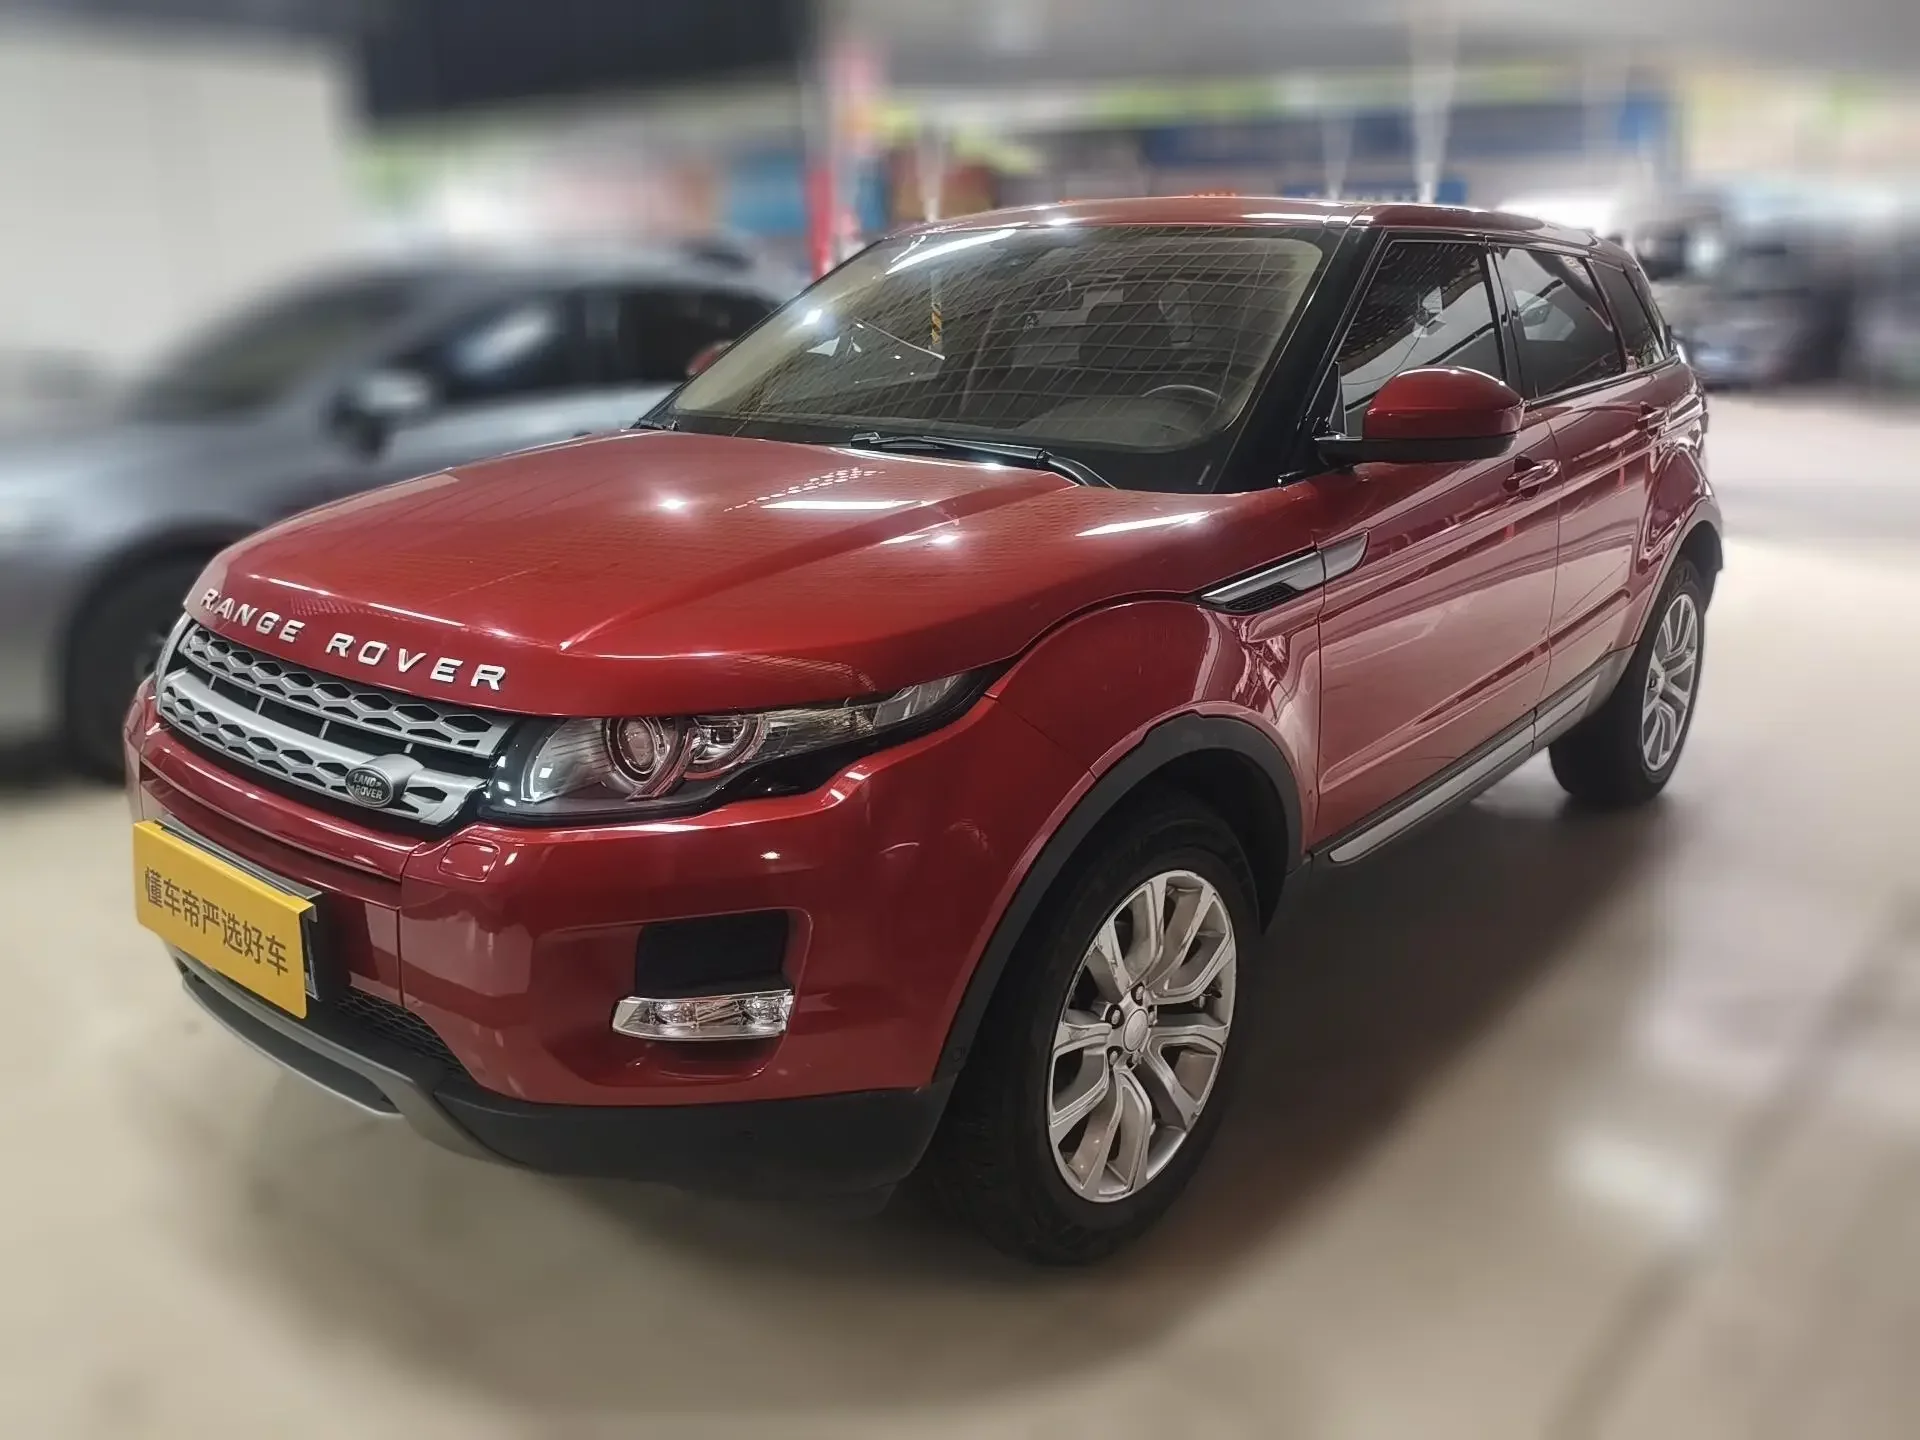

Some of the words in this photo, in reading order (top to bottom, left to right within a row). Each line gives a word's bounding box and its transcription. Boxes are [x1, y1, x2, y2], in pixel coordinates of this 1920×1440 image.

[200, 588, 305, 643] RANGE
[325, 632, 507, 690] ROVER
[353, 773, 377, 787] LAND
[354, 784, 383, 799] ROVER
[145, 867, 288, 976] 懂车帝严选好车
